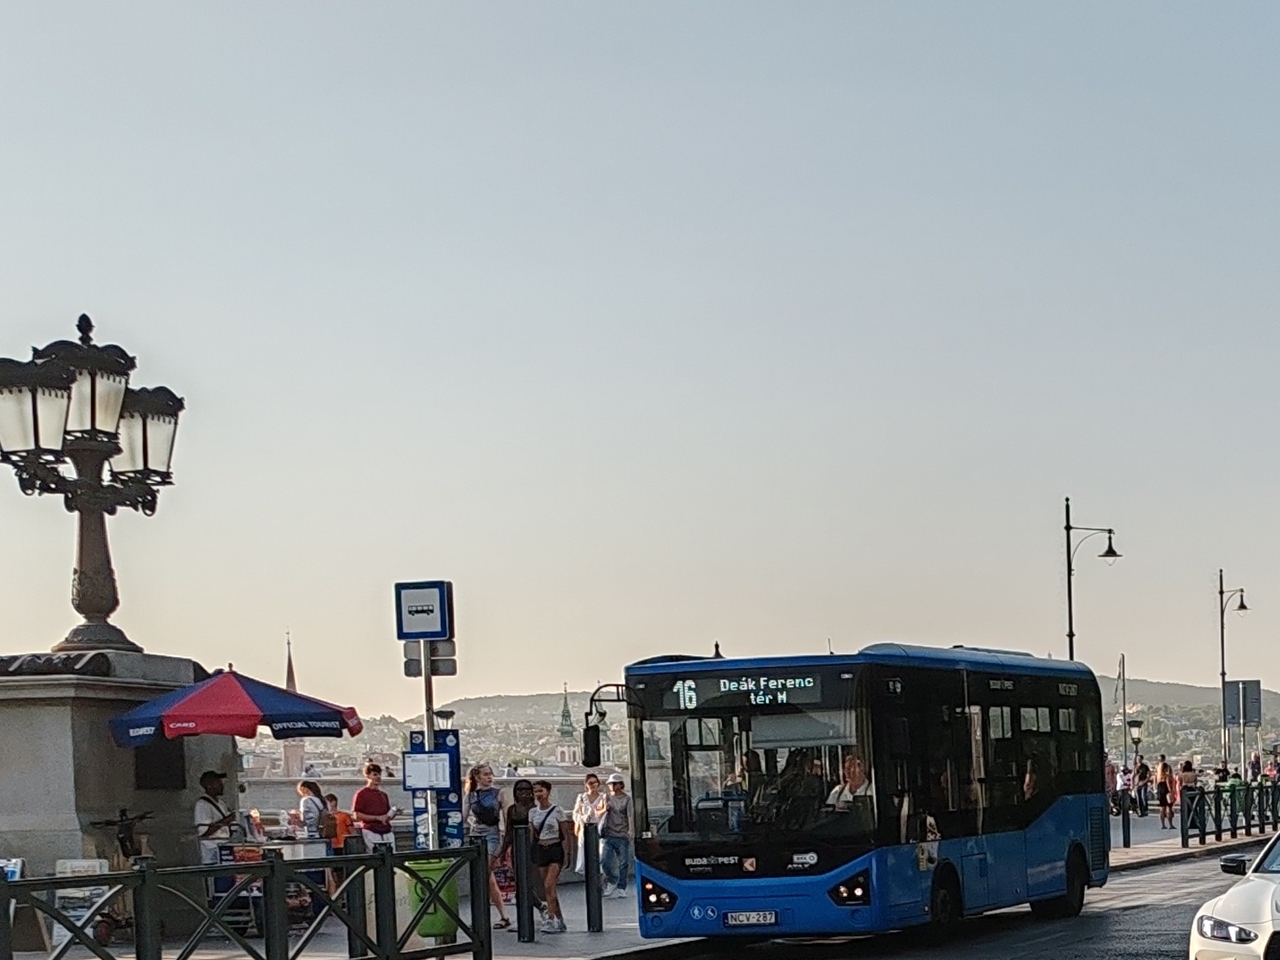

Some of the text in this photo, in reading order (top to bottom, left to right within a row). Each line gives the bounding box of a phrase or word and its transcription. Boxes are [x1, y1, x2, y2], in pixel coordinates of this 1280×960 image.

[720, 677, 814, 692] Deák Ferenc
[673, 680, 697, 710] 16
[749, 691, 774, 706] tér
[272, 721, 309, 731] OFFICIAL
[308, 720, 341, 730] TOURIST
[729, 912, 775, 924] NCV-287
